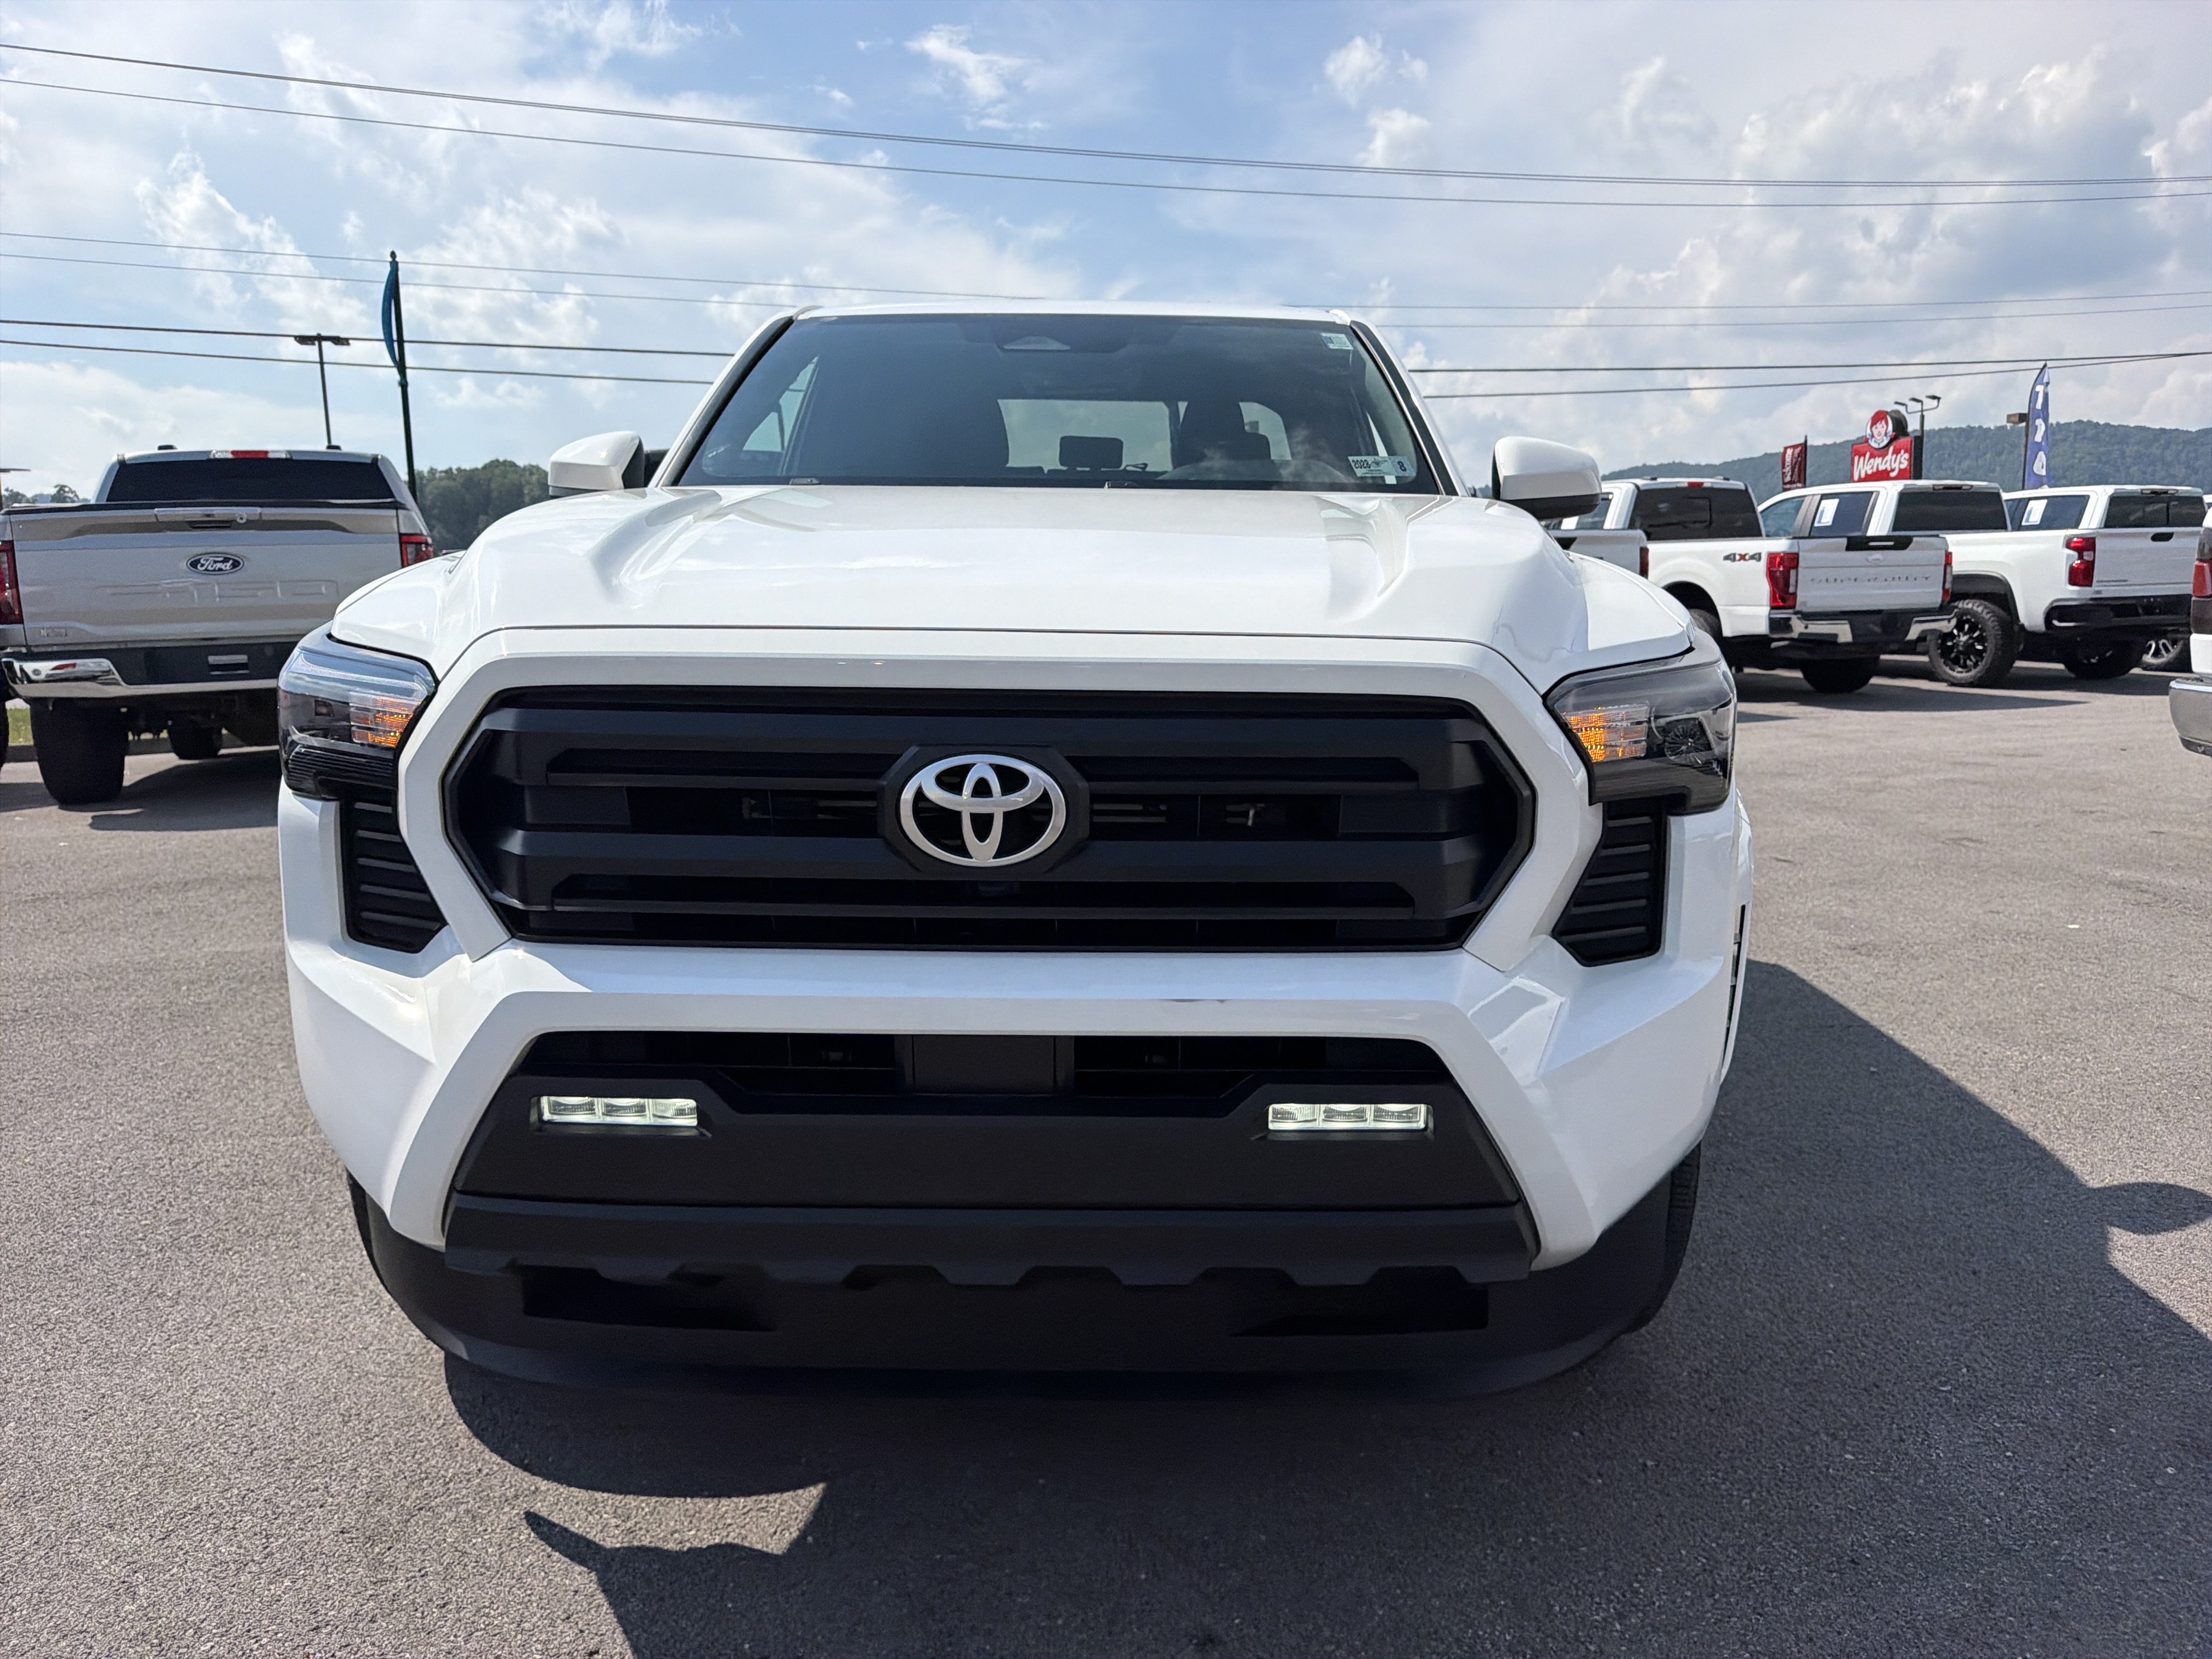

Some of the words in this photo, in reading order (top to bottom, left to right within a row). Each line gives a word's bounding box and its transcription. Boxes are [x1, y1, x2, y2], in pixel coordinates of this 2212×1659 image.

[1397, 461, 1407, 472] 8
[1853, 445, 1909, 481] Wendy's
[197, 557, 233, 571] Ford
